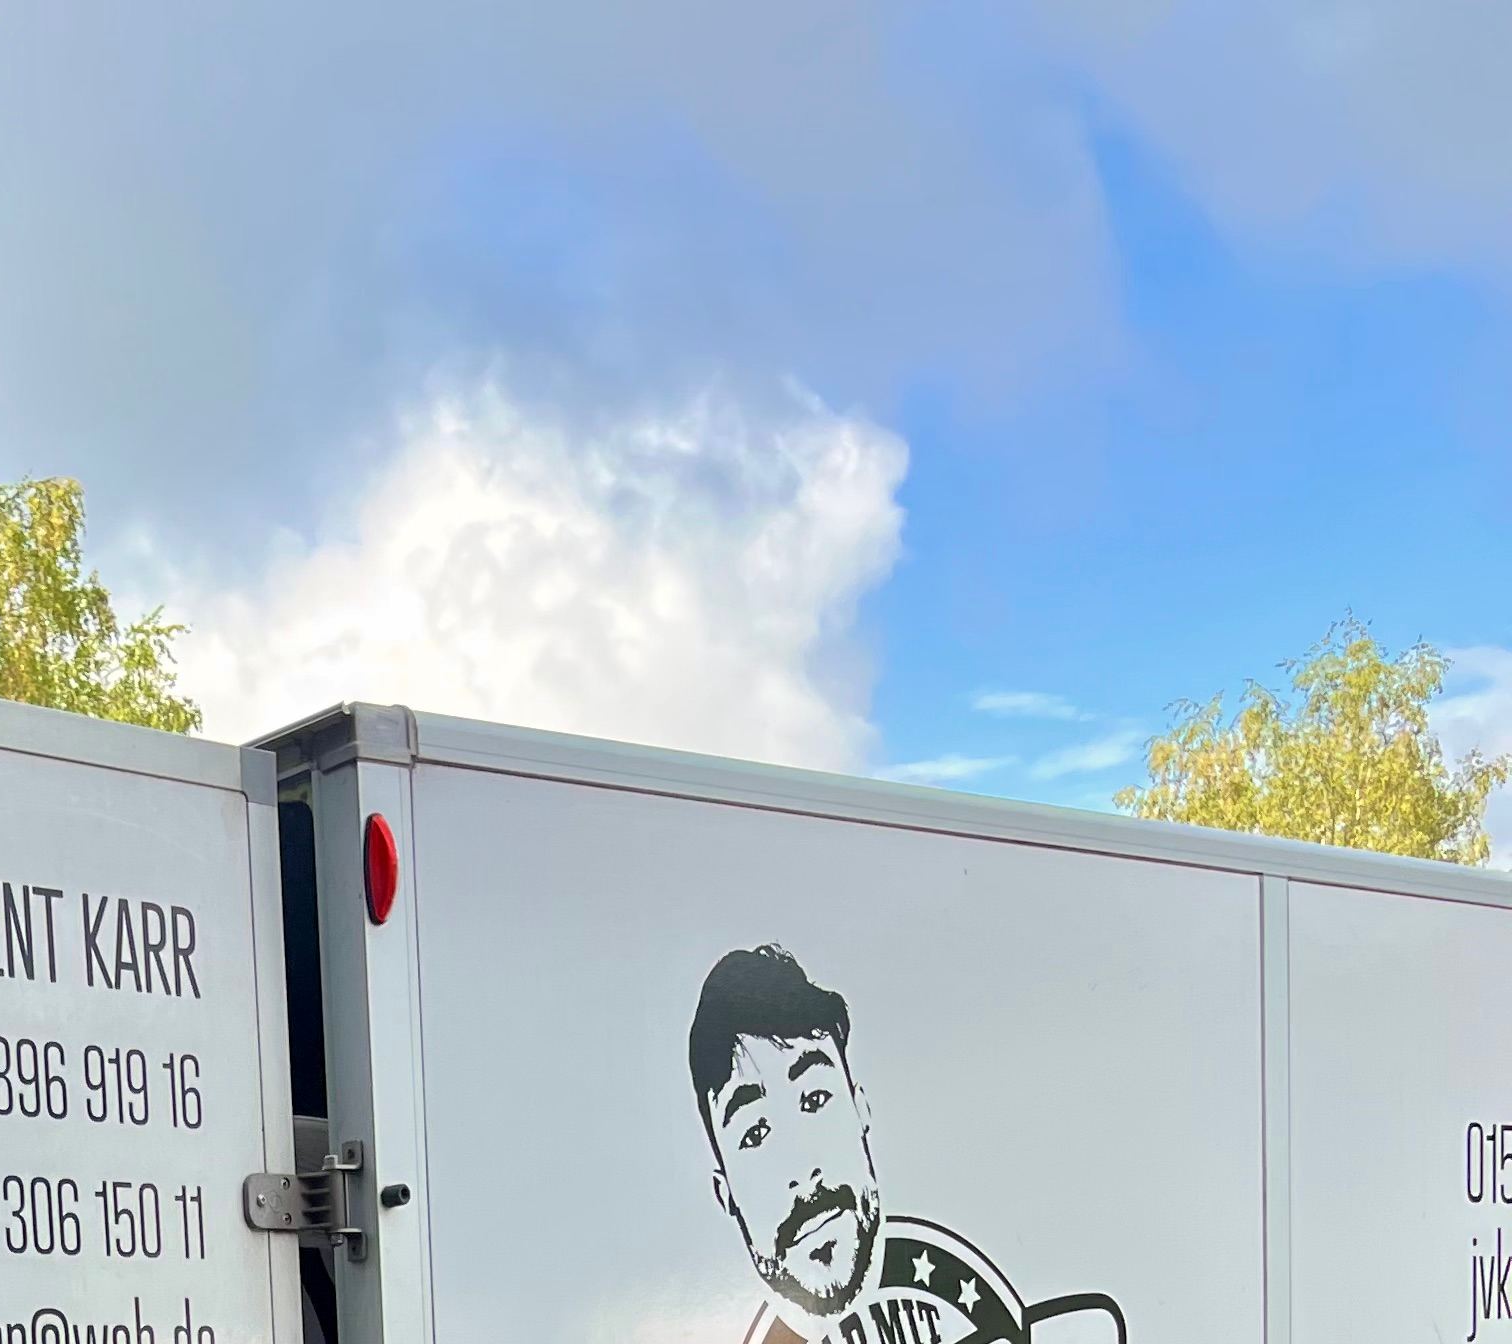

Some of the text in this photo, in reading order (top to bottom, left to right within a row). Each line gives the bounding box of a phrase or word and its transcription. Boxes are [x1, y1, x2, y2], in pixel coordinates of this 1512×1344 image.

[82, 893, 201, 998] KARR
[84, 1046, 150, 1127] 919
[163, 1055, 203, 1130] 16
[3, 1176, 81, 1256] 306
[95, 1180, 162, 1259] 150
[175, 1186, 206, 1260] 11
